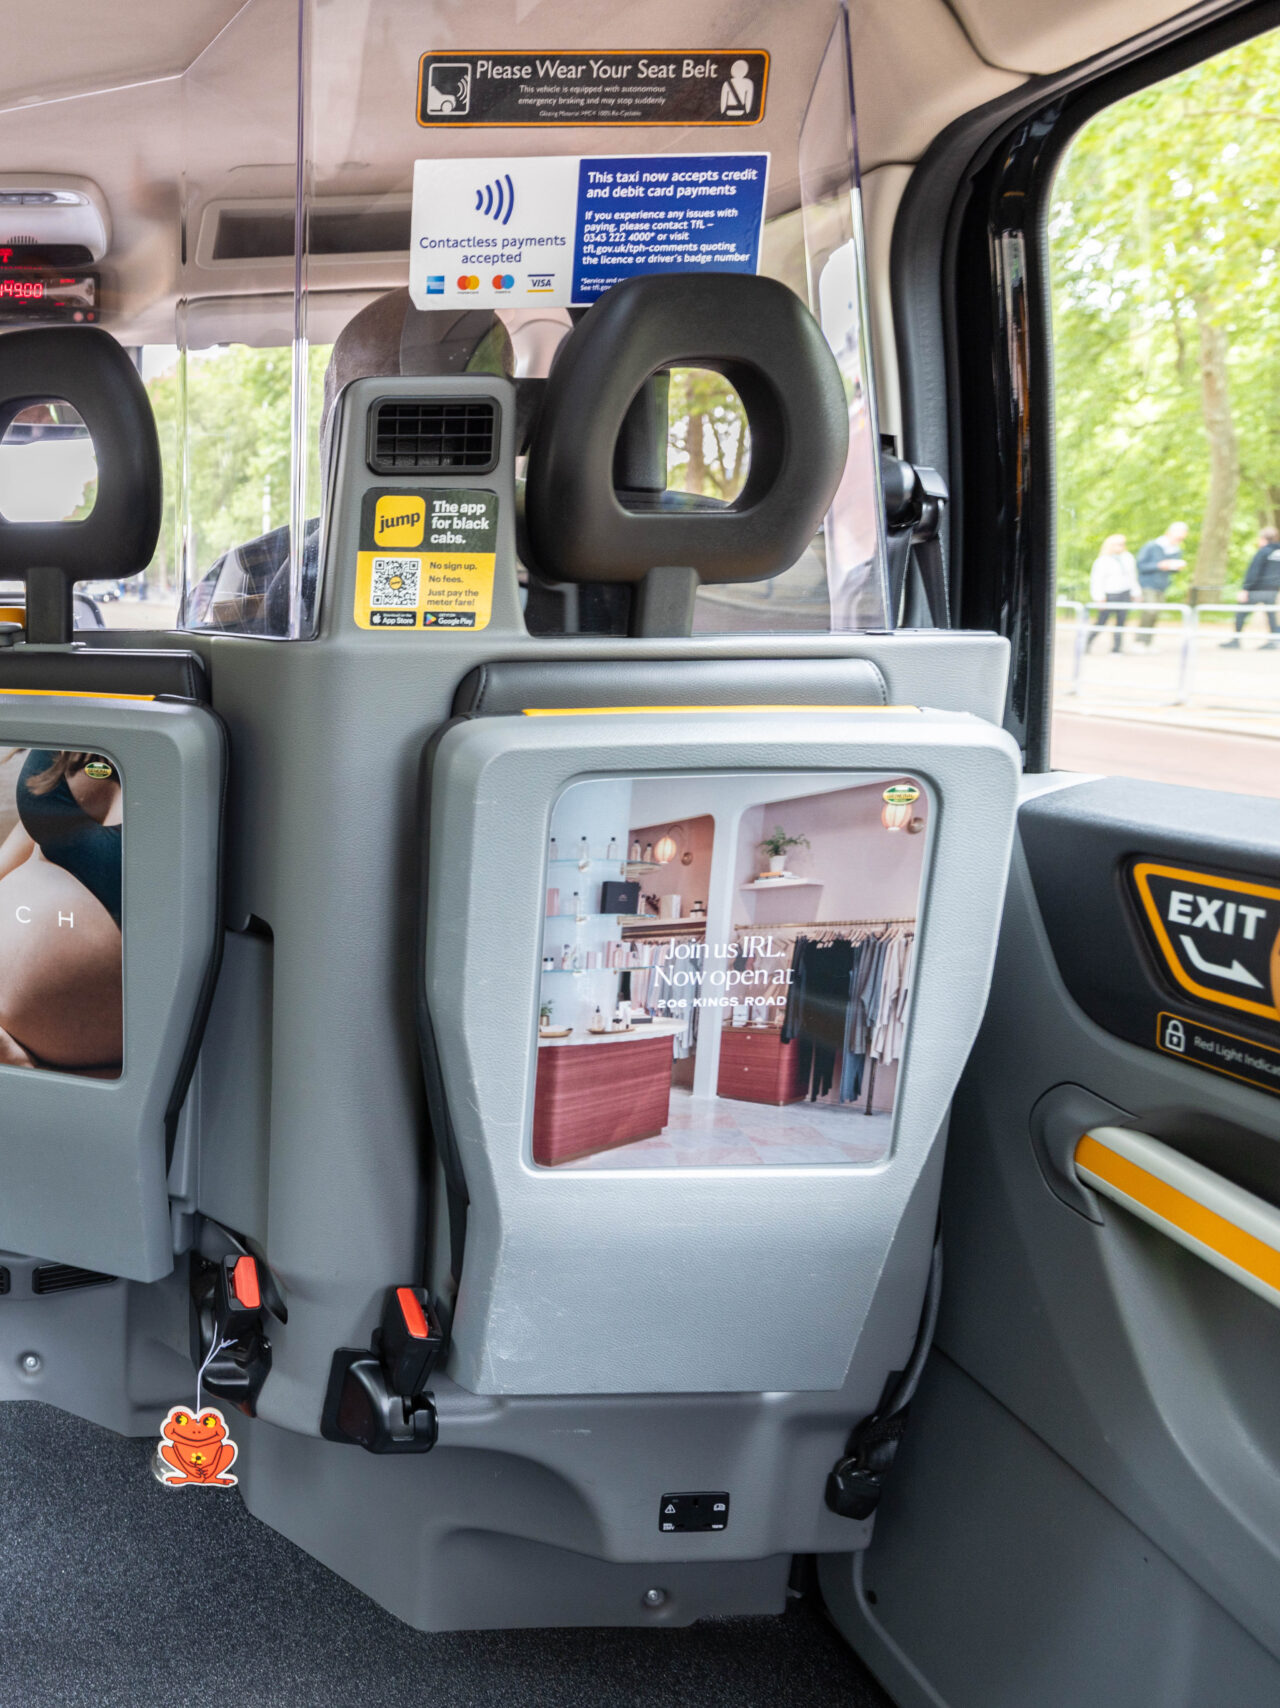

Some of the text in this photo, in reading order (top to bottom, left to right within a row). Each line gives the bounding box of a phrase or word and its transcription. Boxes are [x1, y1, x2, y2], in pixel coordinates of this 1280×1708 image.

[476, 59, 718, 79] Please Wear Your Seat Belt
[520, 85, 666, 95] This vehicle is equipped with autonomous
[518, 96, 666, 106] emergency braking and may stop suddenly
[587, 168, 758, 184] This taxi now accepts credit
[586, 184, 737, 199] and debit card payments
[585, 208, 739, 222] If you experience any issues with
[584, 222, 618, 233] paying,
[619, 221, 651, 232] please
[651, 221, 688, 230] contact
[690, 219, 706, 229] TfL
[420, 235, 566, 249] Contactless payments
[583, 233, 607, 242] 0343
[608, 232, 626, 242] 222
[656, 232, 668, 241] or
[669, 231, 690, 240] visit
[583, 241, 736, 255] tfl.gov.uk/tph-comments quoting
[461, 251, 522, 265] accepted
[582, 255, 599, 265] the
[600, 255, 634, 265] licence
[635, 255, 646, 264] or
[683, 253, 712, 264] badge
[714, 252, 751, 262] number
[531, 279, 552, 288] VISA
[432, 500, 486, 516] The app
[378, 512, 421, 533] jump
[431, 516, 490, 530] for black
[430, 531, 467, 544] cabs.
[429, 561, 477, 572] No sign up.
[428, 575, 464, 583] No fees.
[427, 589, 479, 599] Just pay the
[382, 616, 414, 625] App Store
[437, 617, 474, 626] Google Play
[1167, 889, 1267, 941] EXIT
[665, 935, 786, 960] Join us IRL.
[653, 965, 795, 991] Now open at
[657, 996, 787, 1009] 206 KINGS ROAD
[1193, 1035, 1280, 1077] Red Light Indica
